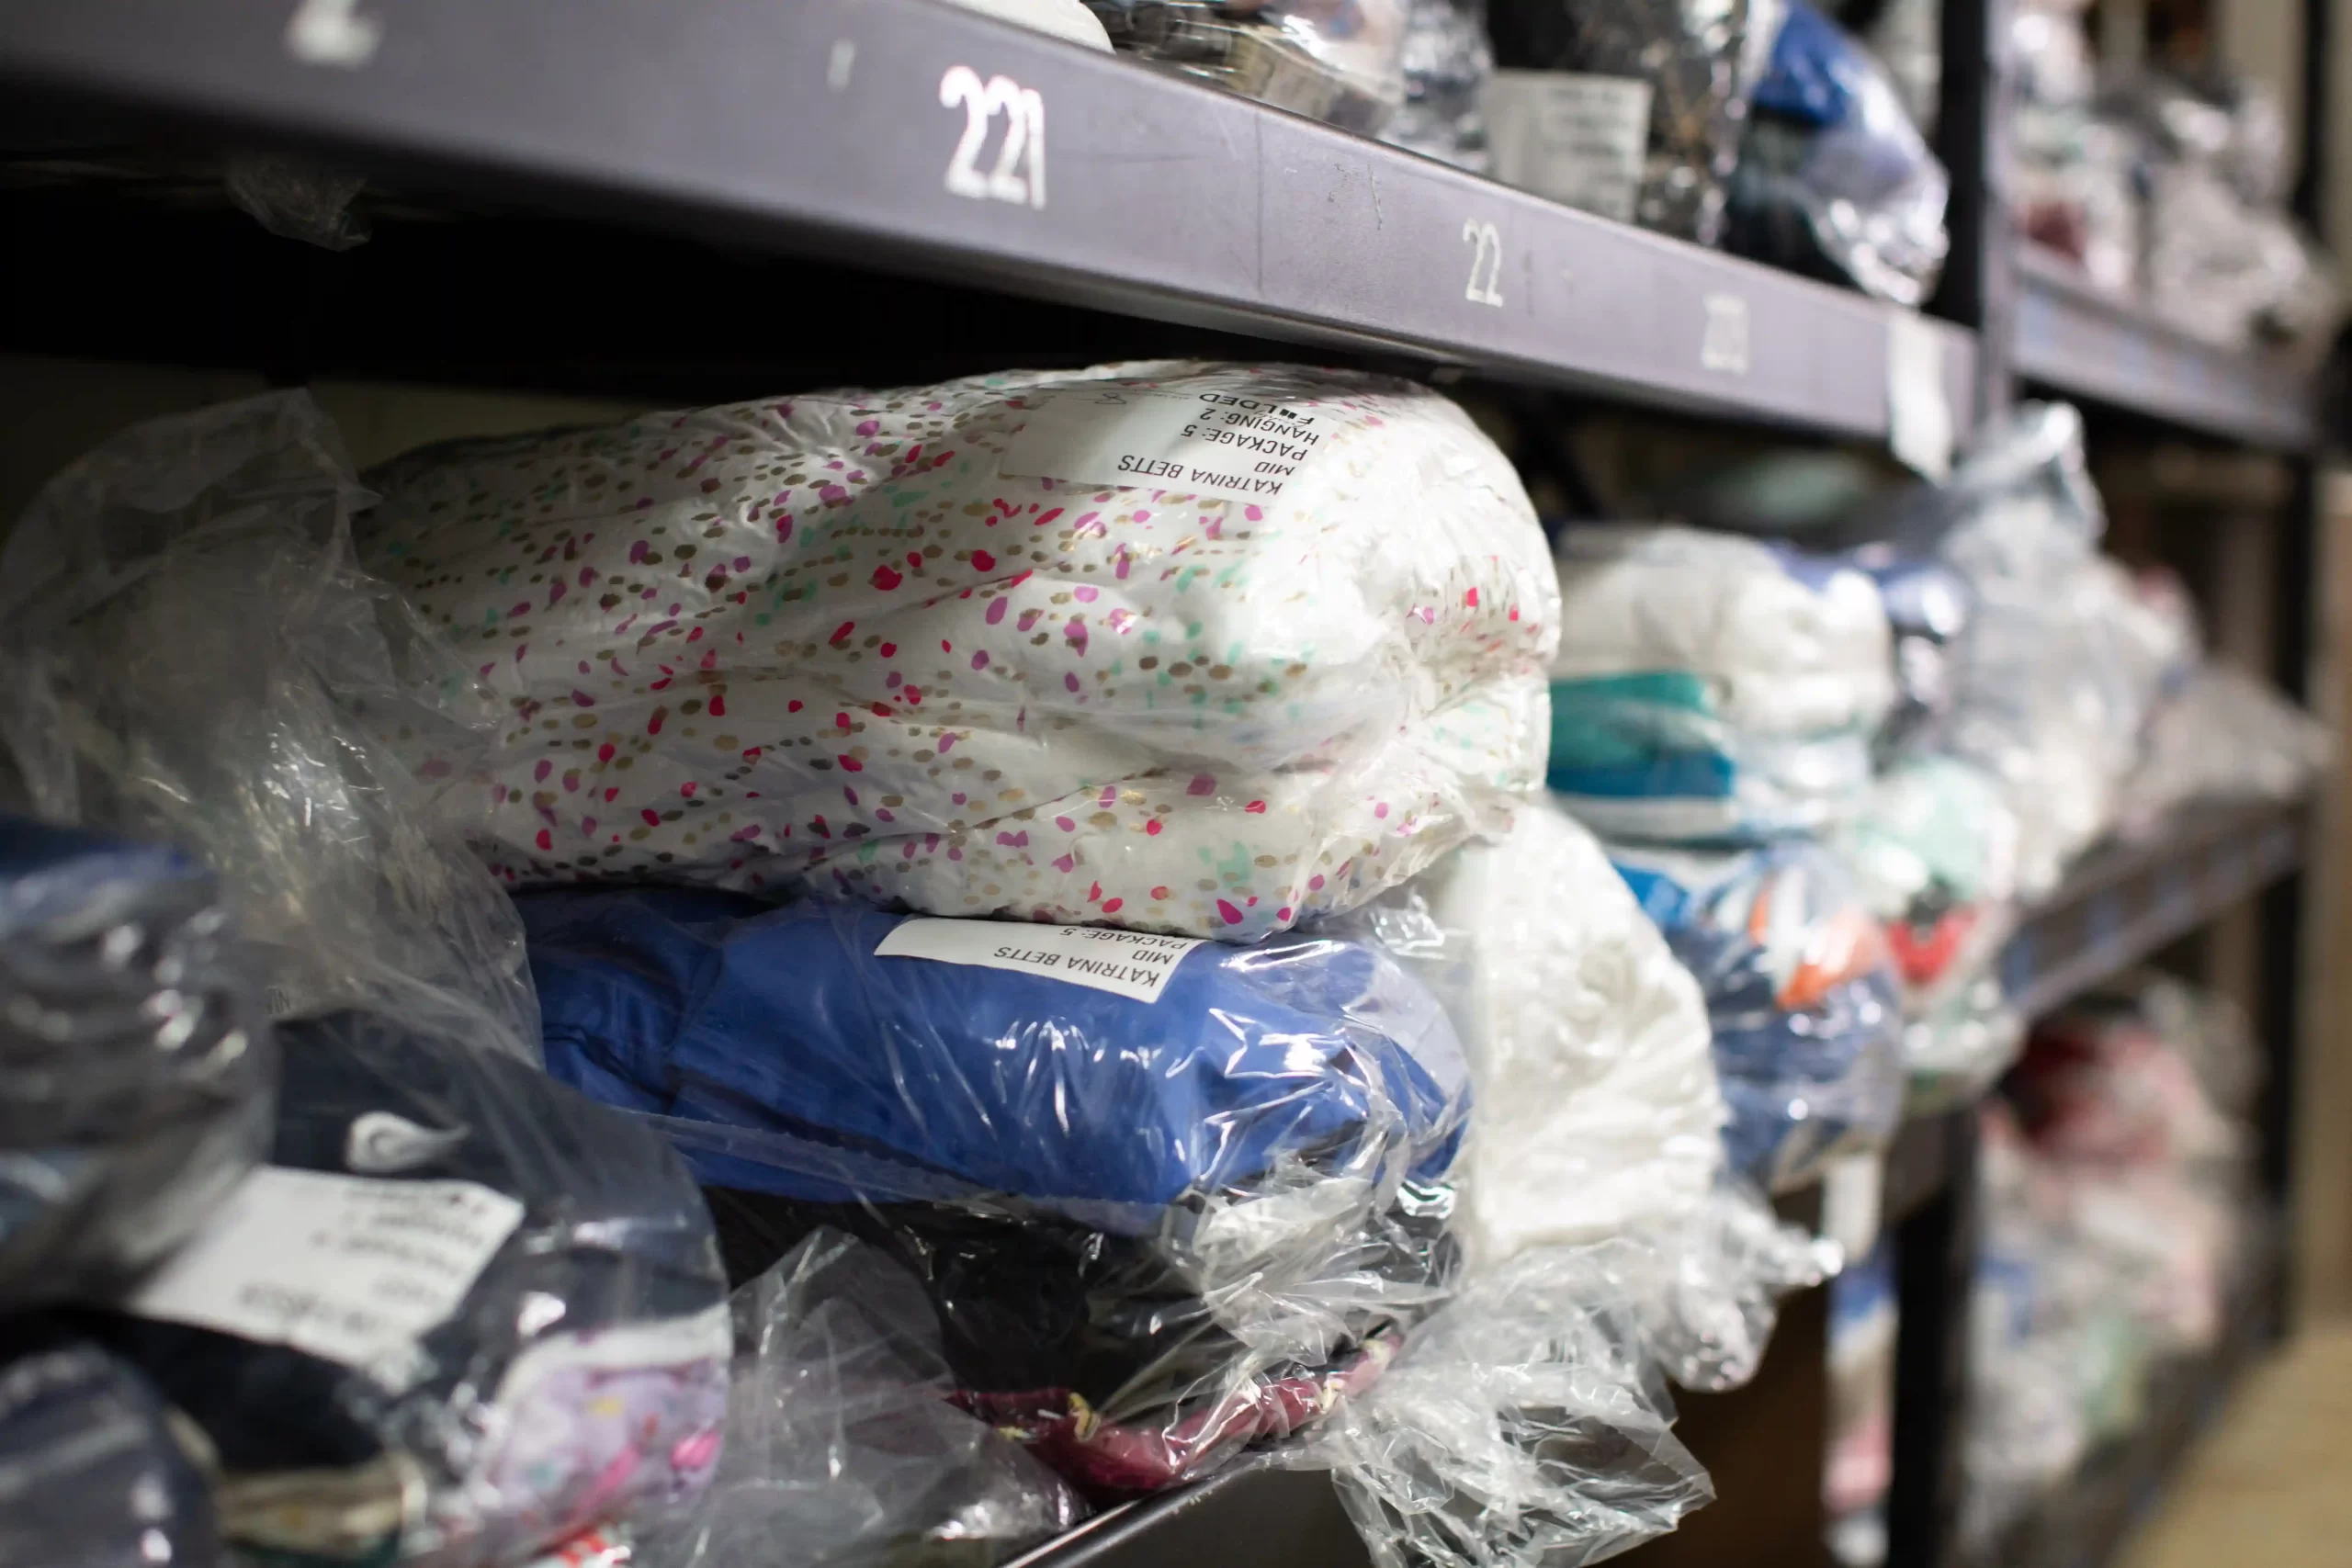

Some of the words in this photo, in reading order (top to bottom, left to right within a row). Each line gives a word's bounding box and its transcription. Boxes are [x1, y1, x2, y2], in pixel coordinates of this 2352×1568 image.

[938, 65, 1046, 211] 221
[1199, 393, 1315, 425] FLDED
[1200, 408, 1217, 421] 2
[1181, 424, 1198, 437] 5
[1220, 412, 1319, 446] HANGING:
[1202, 428, 1308, 461] PACKAGE:
[1117, 455, 1183, 479] BETTS
[1254, 461, 1295, 476] MID
[1191, 468, 1283, 495] KATRINA
[1059, 928, 1078, 936] 5
[1081, 930, 1188, 950] PACKAGE:
[993, 946, 1062, 965] BETTS
[1132, 949, 1174, 964] MID
[1068, 956, 1160, 987] KATRINA
